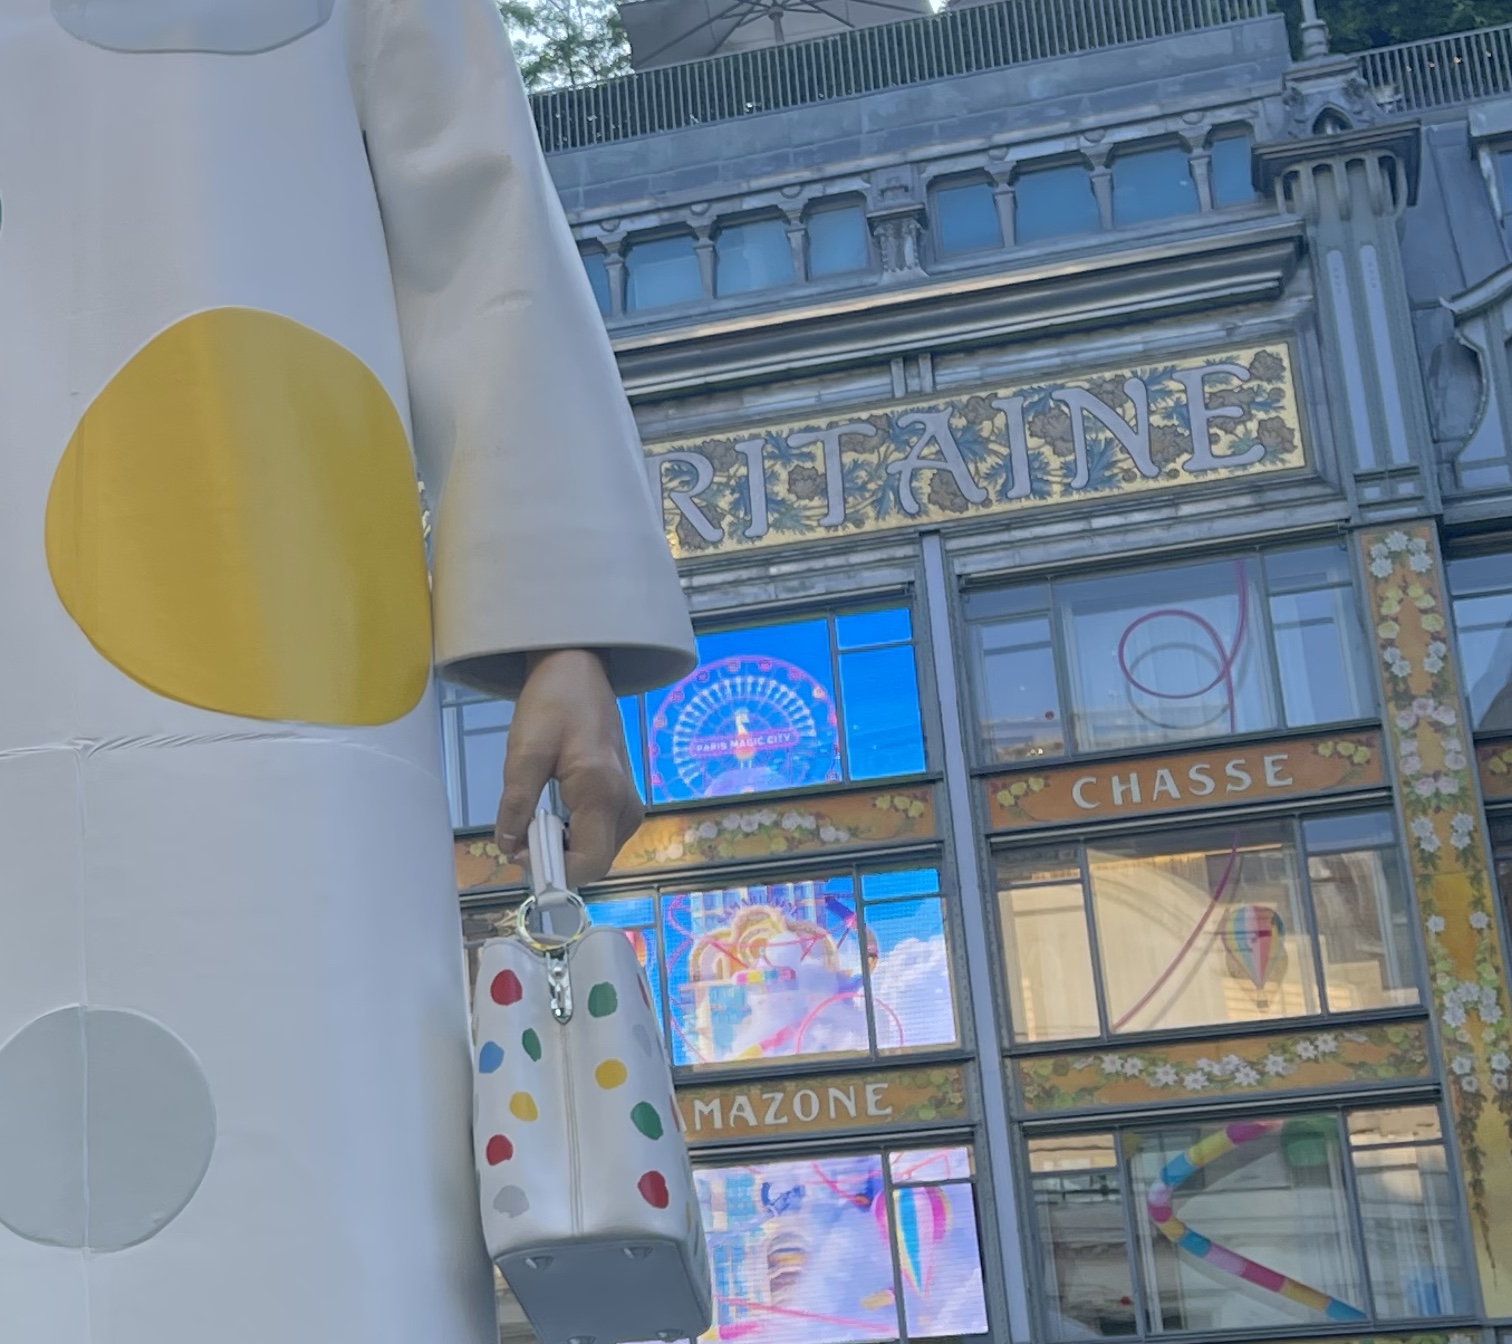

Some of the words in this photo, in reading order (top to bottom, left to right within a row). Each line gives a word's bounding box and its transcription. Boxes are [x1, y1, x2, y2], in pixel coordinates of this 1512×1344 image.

[696, 742, 728, 752] PARIS
[730, 735, 764, 748] MAGIC
[767, 733, 792, 745] CITY
[1071, 754, 1292, 809] CHASSE
[674, 1083, 893, 1131] MAZONE
